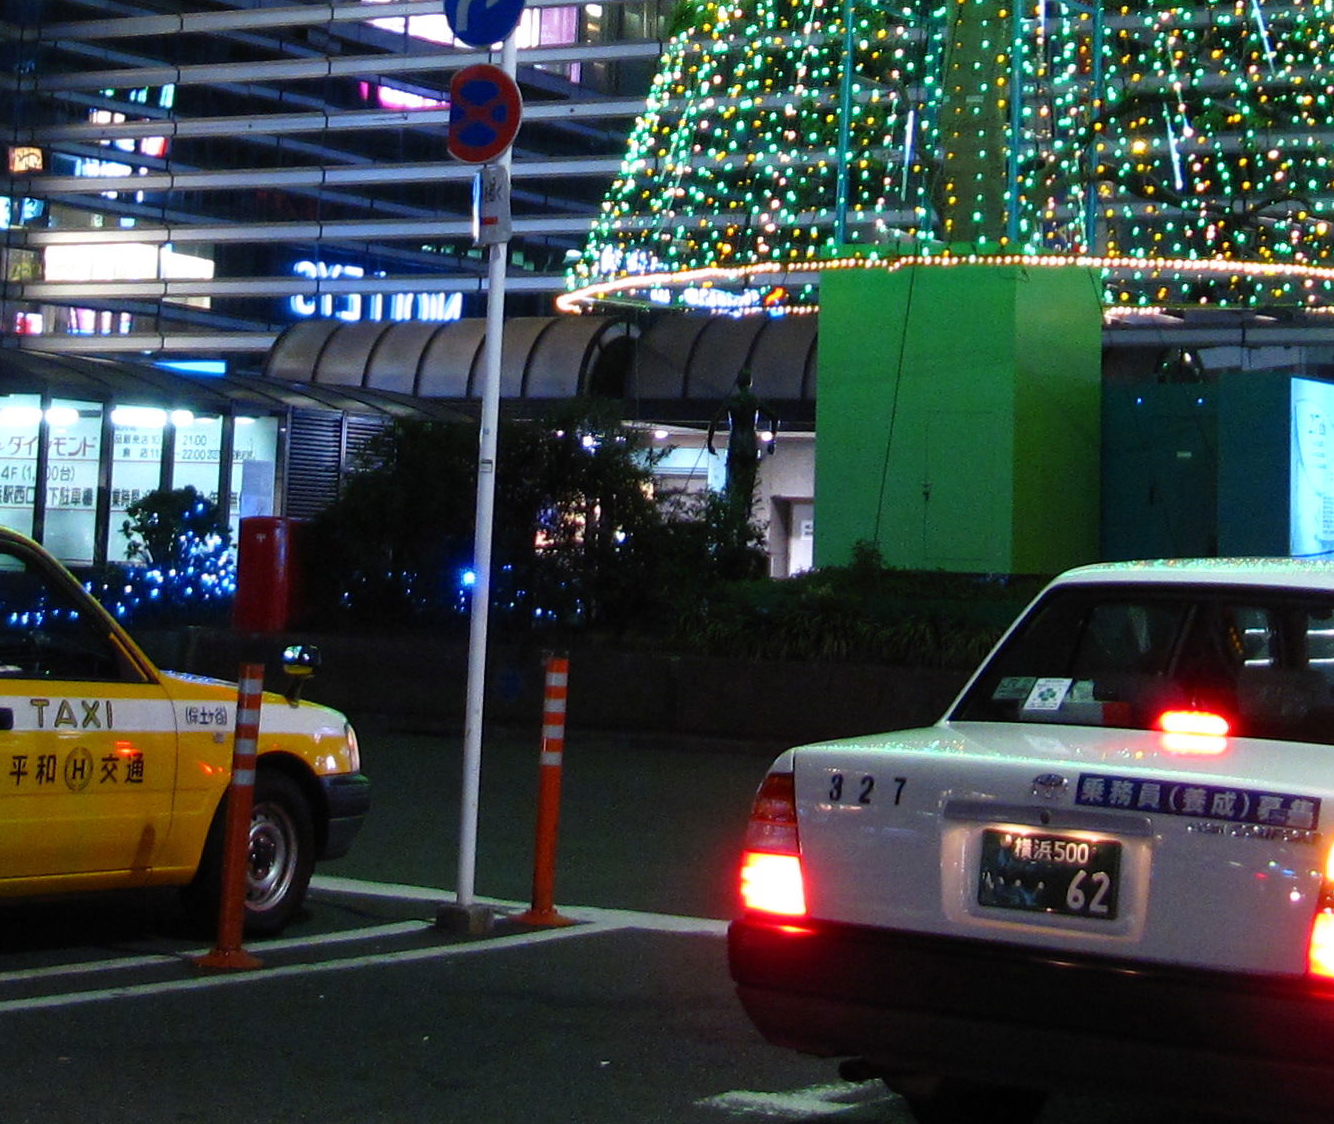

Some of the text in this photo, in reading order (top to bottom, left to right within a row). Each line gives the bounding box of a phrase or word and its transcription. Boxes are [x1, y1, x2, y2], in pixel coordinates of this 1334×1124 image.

[8, 434, 98, 457] ダイモンド
[30, 699, 113, 729] TAXI
